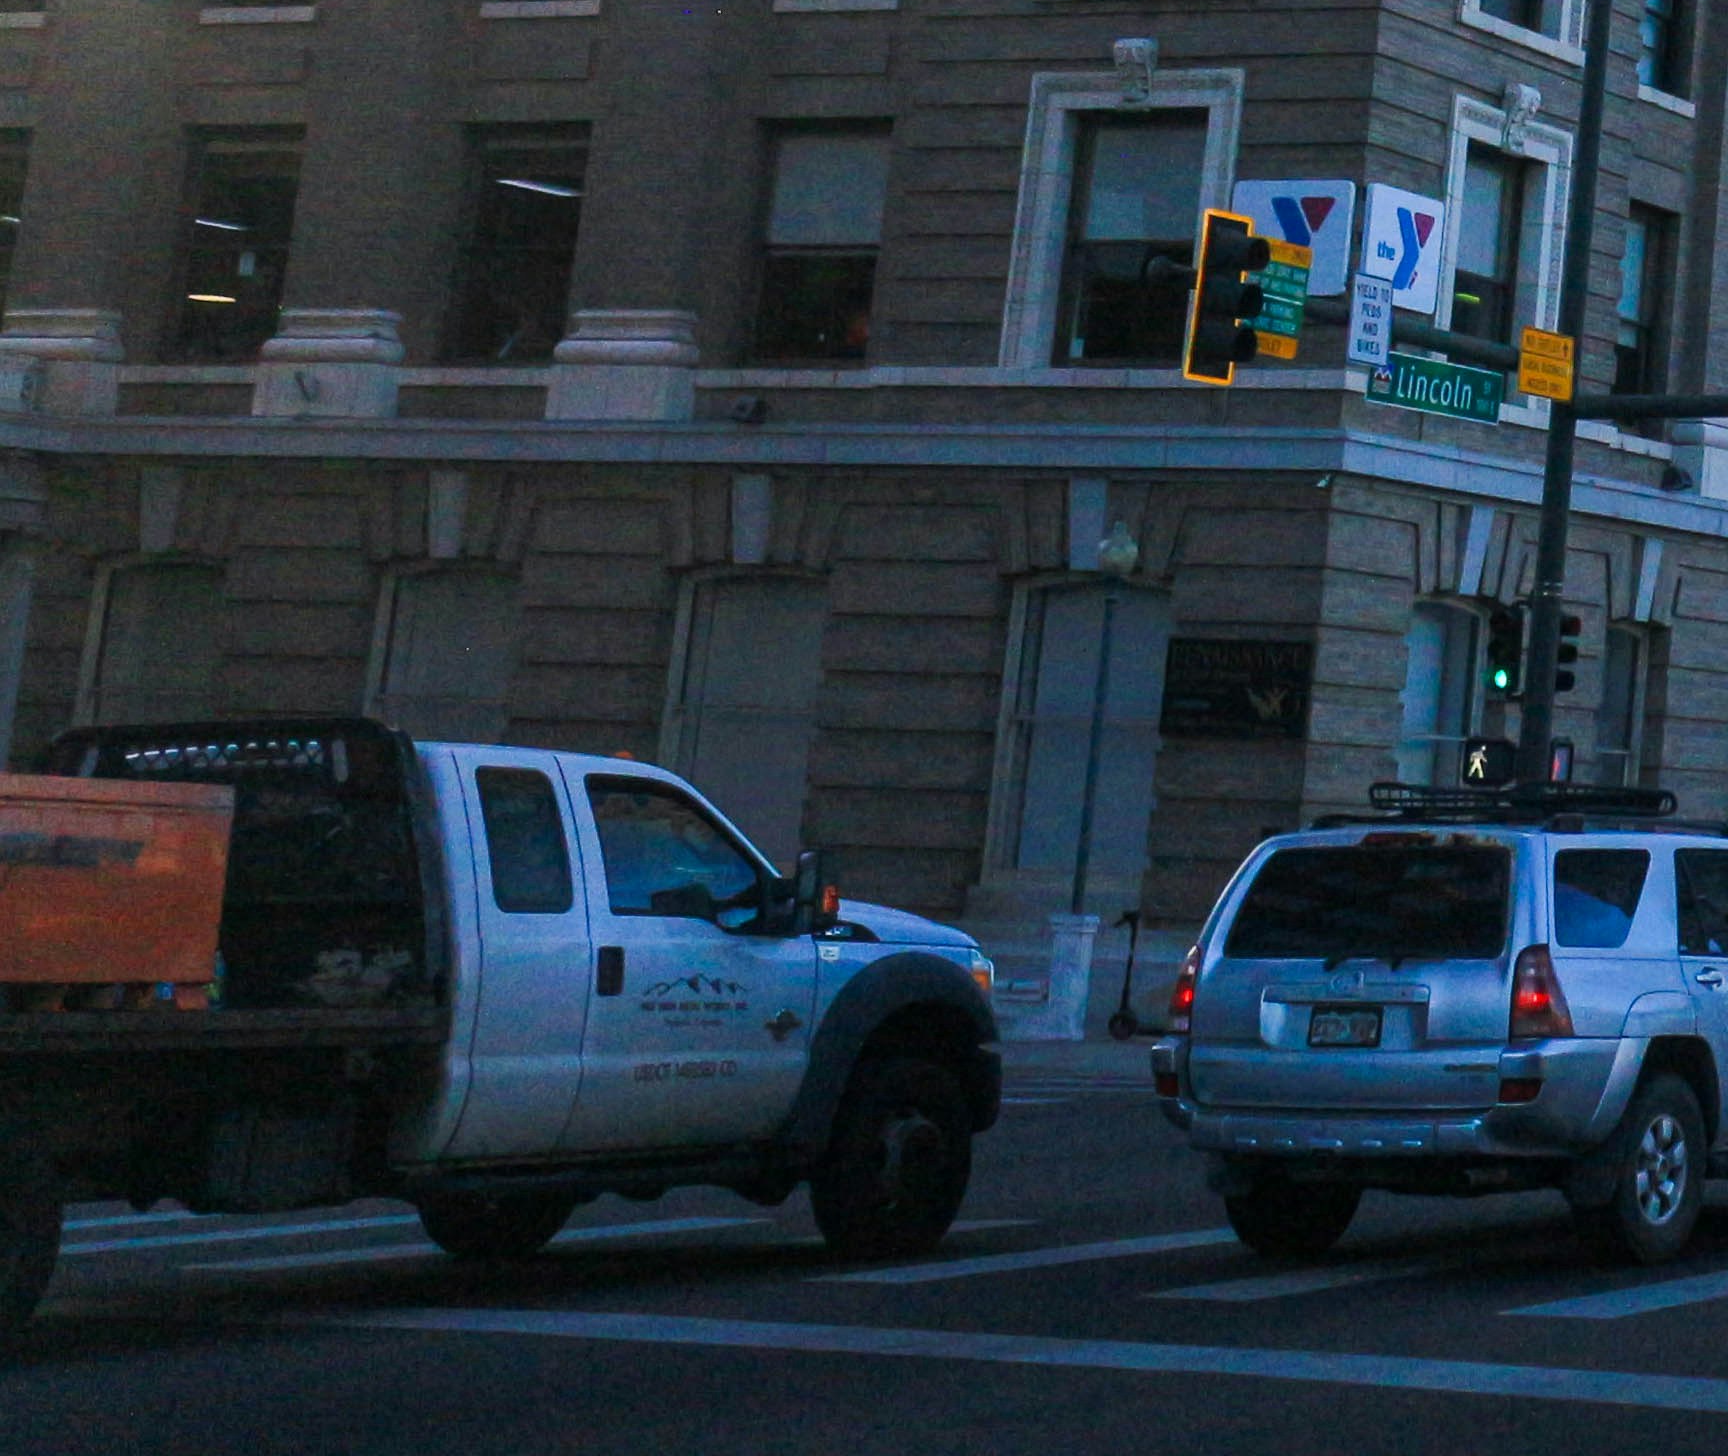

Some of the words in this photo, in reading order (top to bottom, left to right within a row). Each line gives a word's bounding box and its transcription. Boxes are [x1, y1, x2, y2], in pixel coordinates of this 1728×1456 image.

[1377, 240, 1396, 261] the
[1356, 283, 1378, 300] YIELD
[1362, 321, 1378, 337] AND
[1356, 339, 1381, 356] BIKES
[1396, 366, 1473, 411] Lincoln
